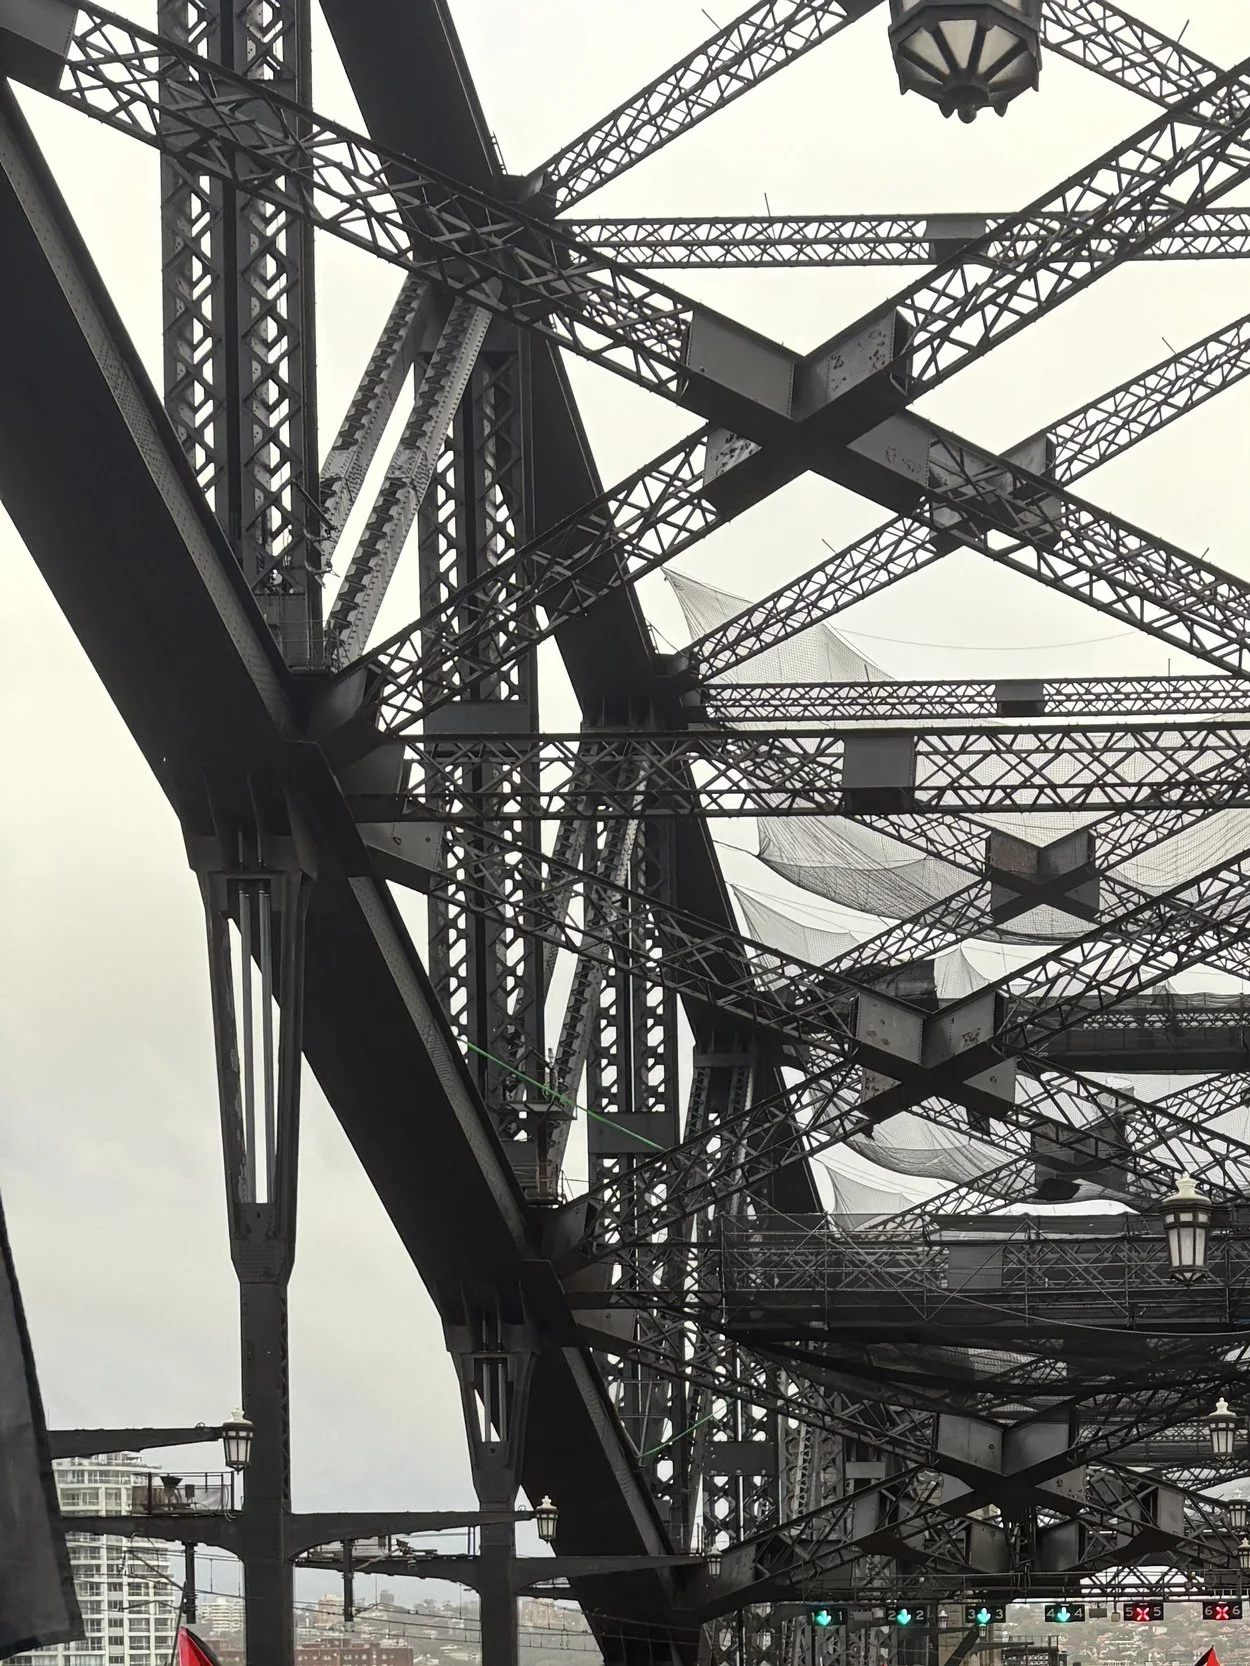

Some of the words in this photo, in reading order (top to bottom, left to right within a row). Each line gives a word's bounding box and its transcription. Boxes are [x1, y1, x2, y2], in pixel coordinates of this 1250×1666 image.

[887, 1610, 896, 1620] 2
[915, 1610, 924, 1620] 2
[968, 1609, 976, 1619] 3
[995, 1609, 1003, 1619] 3
[1046, 1608, 1056, 1618] 4
[1074, 1608, 1083, 1618] 4
[1126, 1607, 1134, 1617] 5
[1154, 1607, 1162, 1617] 5
[1205, 1606, 1213, 1616] 6
[1232, 1606, 1241, 1616] 6
